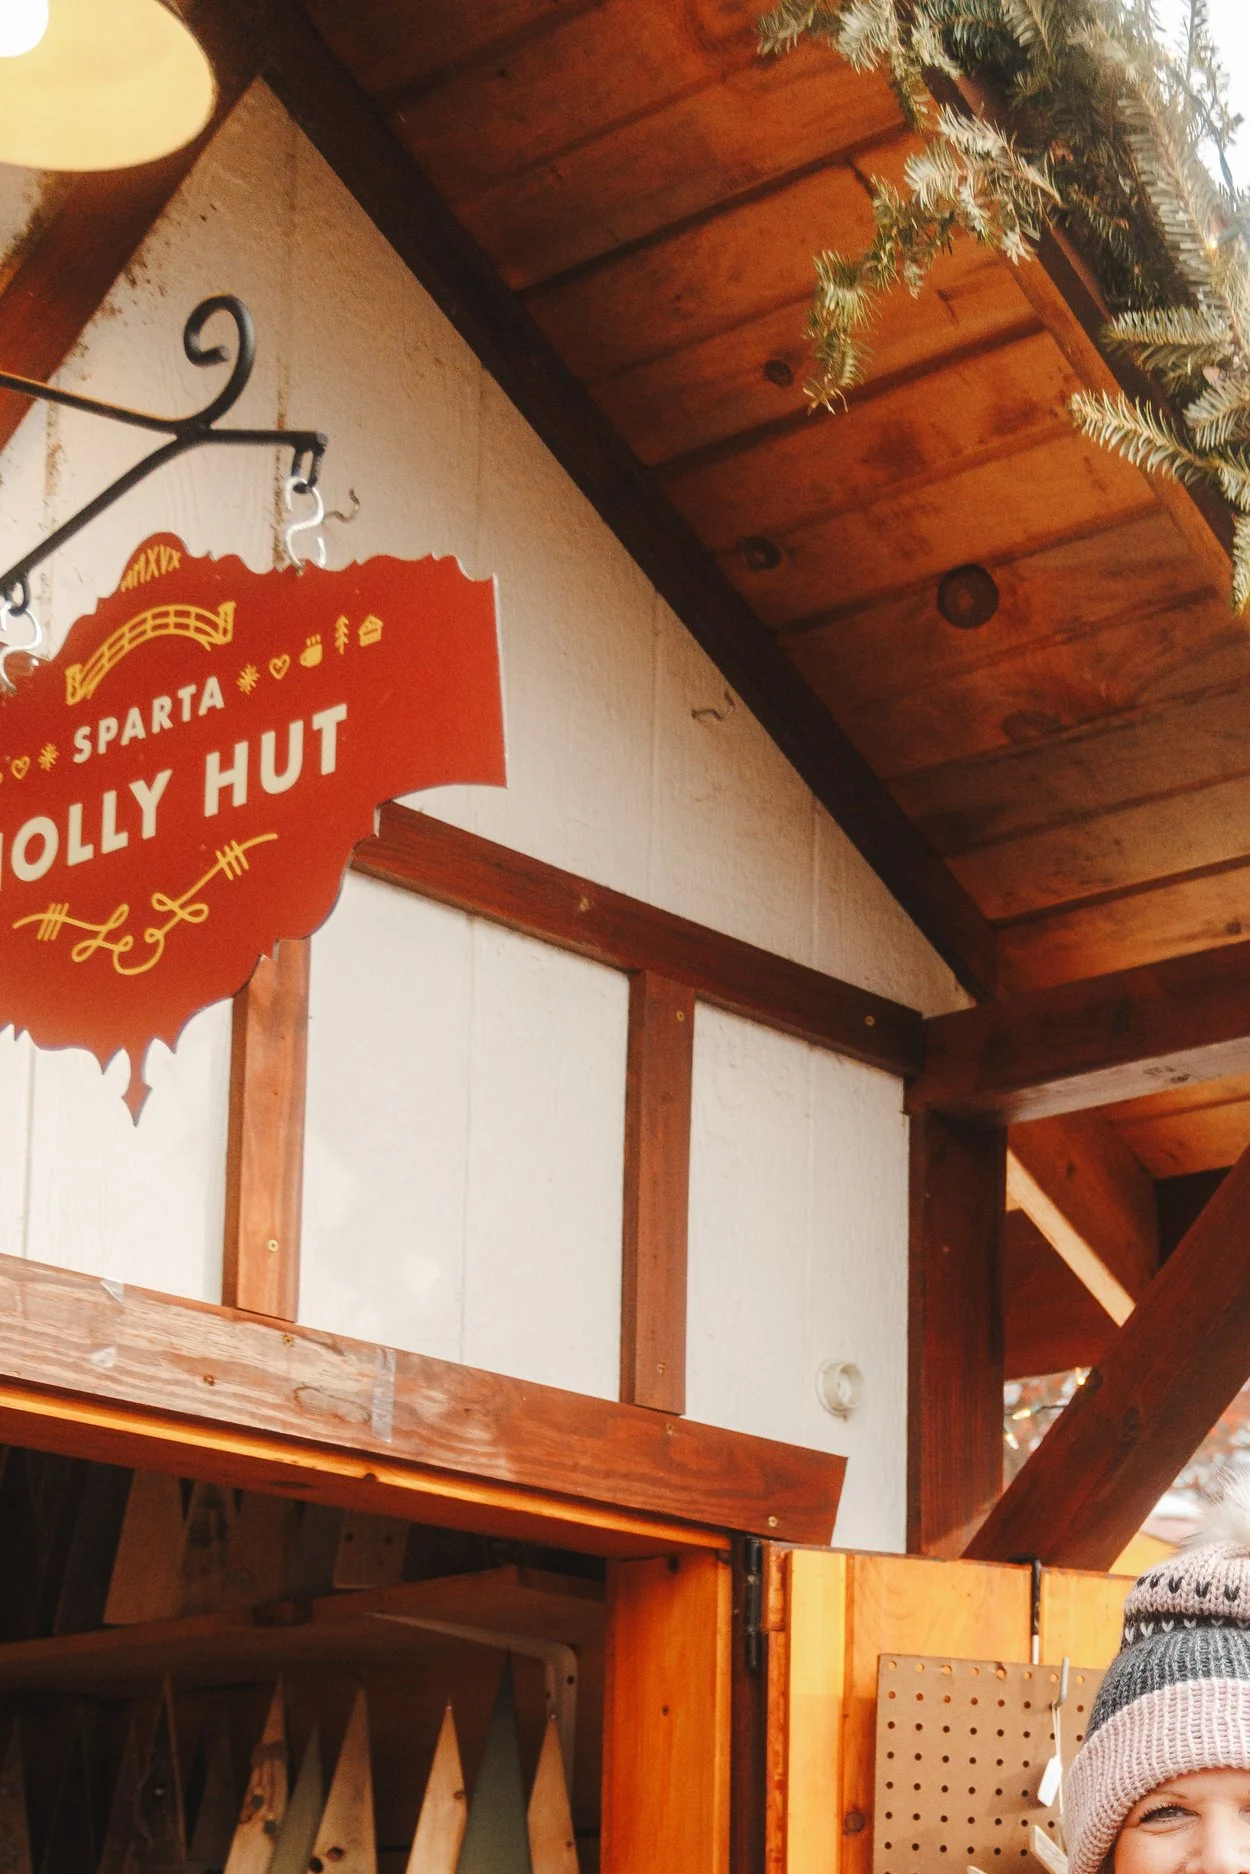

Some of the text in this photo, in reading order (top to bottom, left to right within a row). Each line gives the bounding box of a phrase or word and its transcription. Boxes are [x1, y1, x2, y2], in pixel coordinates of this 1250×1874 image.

[72, 676, 226, 765] SPARTA
[0, 703, 348, 893] OLLY HUT
